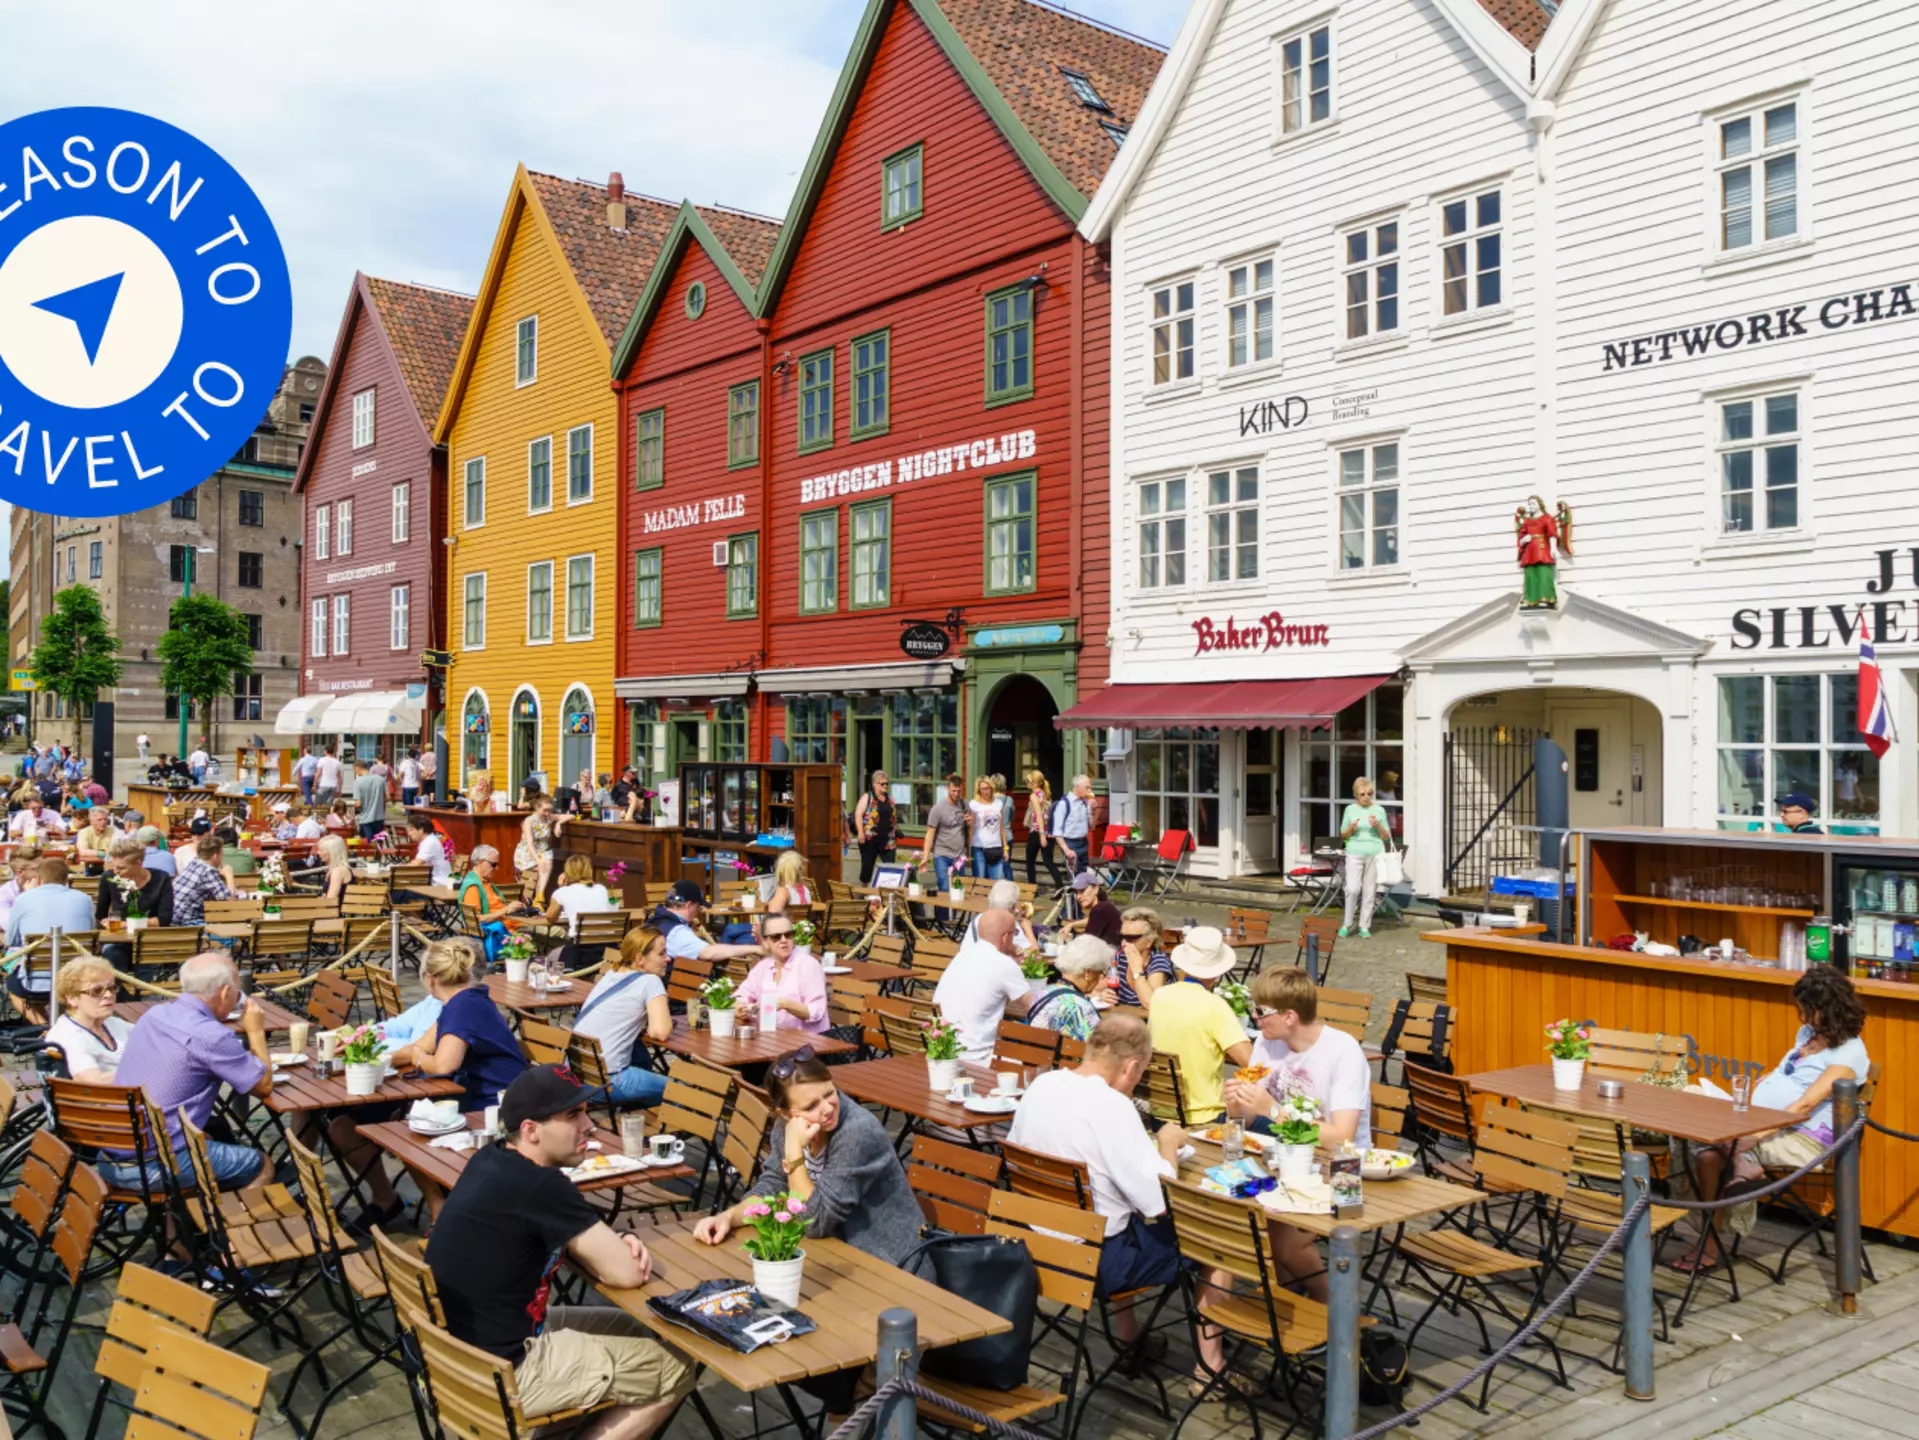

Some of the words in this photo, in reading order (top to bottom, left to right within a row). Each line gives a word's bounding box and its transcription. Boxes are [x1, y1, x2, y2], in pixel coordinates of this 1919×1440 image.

[1602, 305, 1809, 373] NETWORK
[1819, 284, 1919, 330] CHA
[1240, 396, 1309, 437] KIND
[1332, 389, 1379, 407] Conceptual
[1332, 405, 1371, 421] Branding
[801, 460, 893, 504] BRYGGEN
[897, 428, 1037, 484] NIGHTCLUB
[643, 502, 700, 534] MADAM
[703, 493, 746, 523] FELLE
[1730, 599, 1919, 650] SILVE
